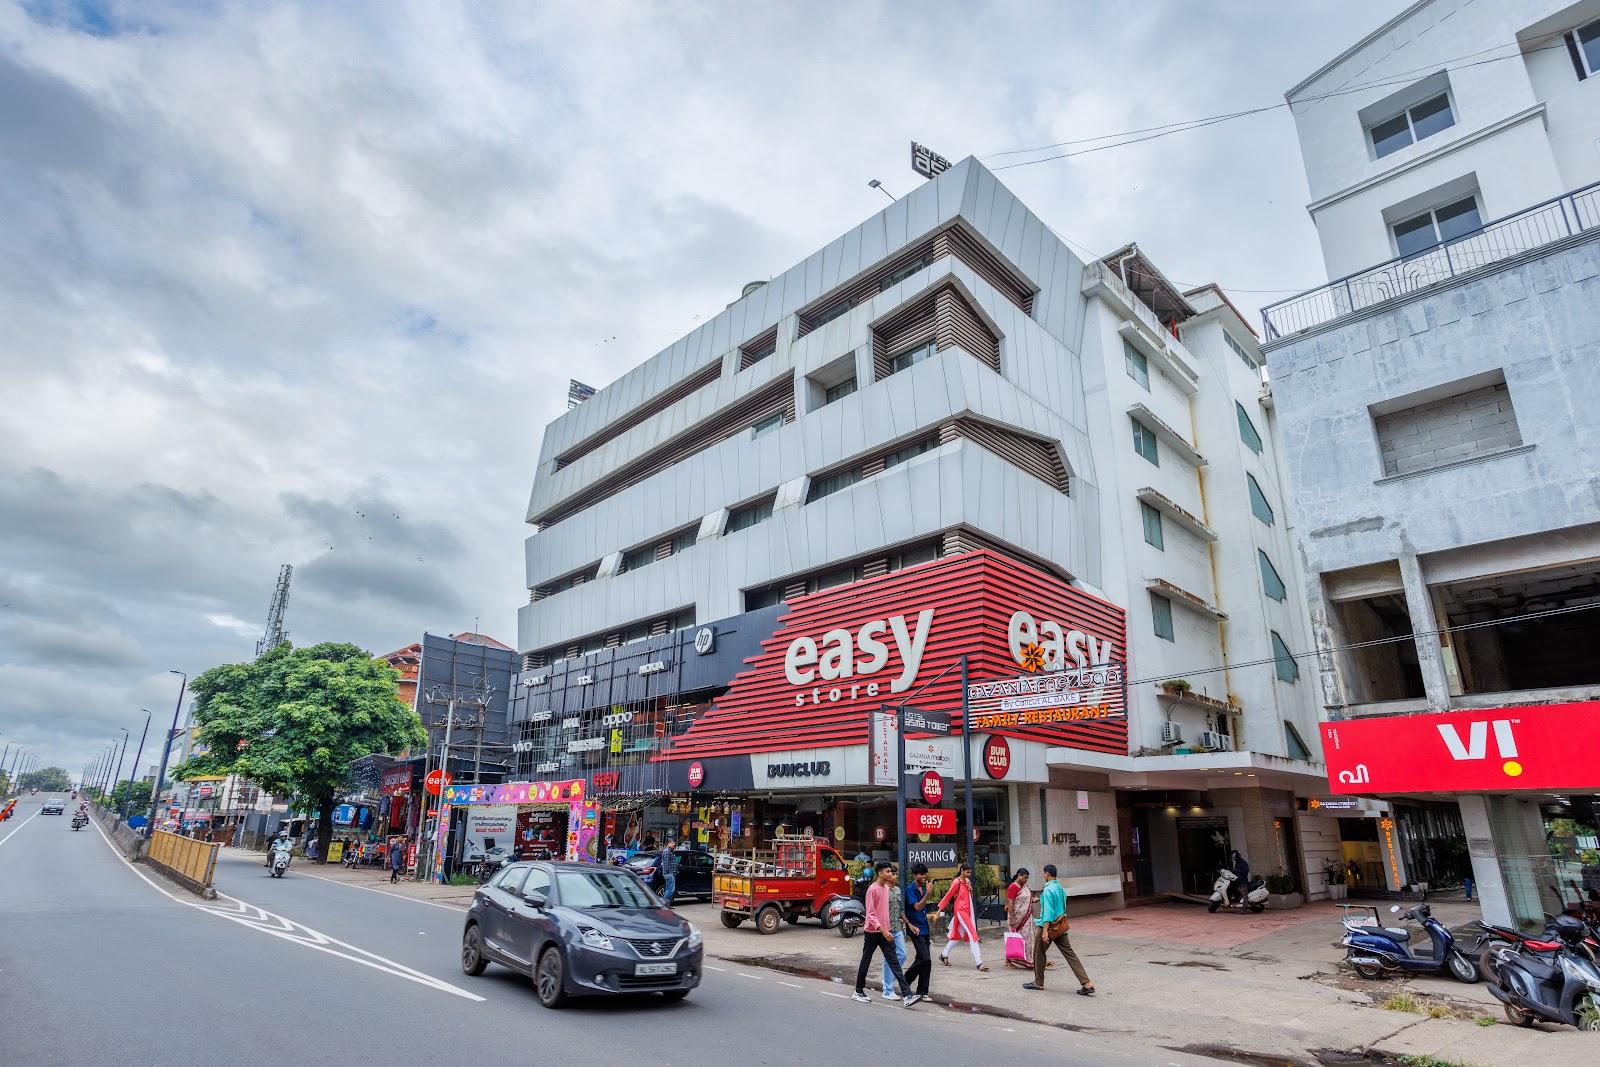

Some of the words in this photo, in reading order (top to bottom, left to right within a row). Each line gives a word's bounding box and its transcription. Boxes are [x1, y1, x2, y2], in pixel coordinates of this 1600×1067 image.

[696, 628, 710, 653] hp
[784, 608, 935, 693] easy
[639, 661, 665, 675] NOKIA
[523, 675, 546, 687] SONY
[577, 675, 593, 686] TCL
[795, 679, 879, 707] store
[904, 711, 926, 721] HOTEL
[975, 713, 1020, 728] FAMILY
[1024, 703, 1111, 724] RESTAURANT
[991, 745, 1006, 757] BUN
[988, 755, 1008, 767] CLUB
[428, 775, 450, 785] eay
[593, 771, 619, 790] easy
[1338, 764, 1370, 784] വി
[926, 778, 940, 787] BUN
[924, 785, 942, 795] CLUB
[920, 814, 943, 828] easy
[1052, 832, 1080, 845] HOTEL
[909, 849, 949, 862] PARKING
